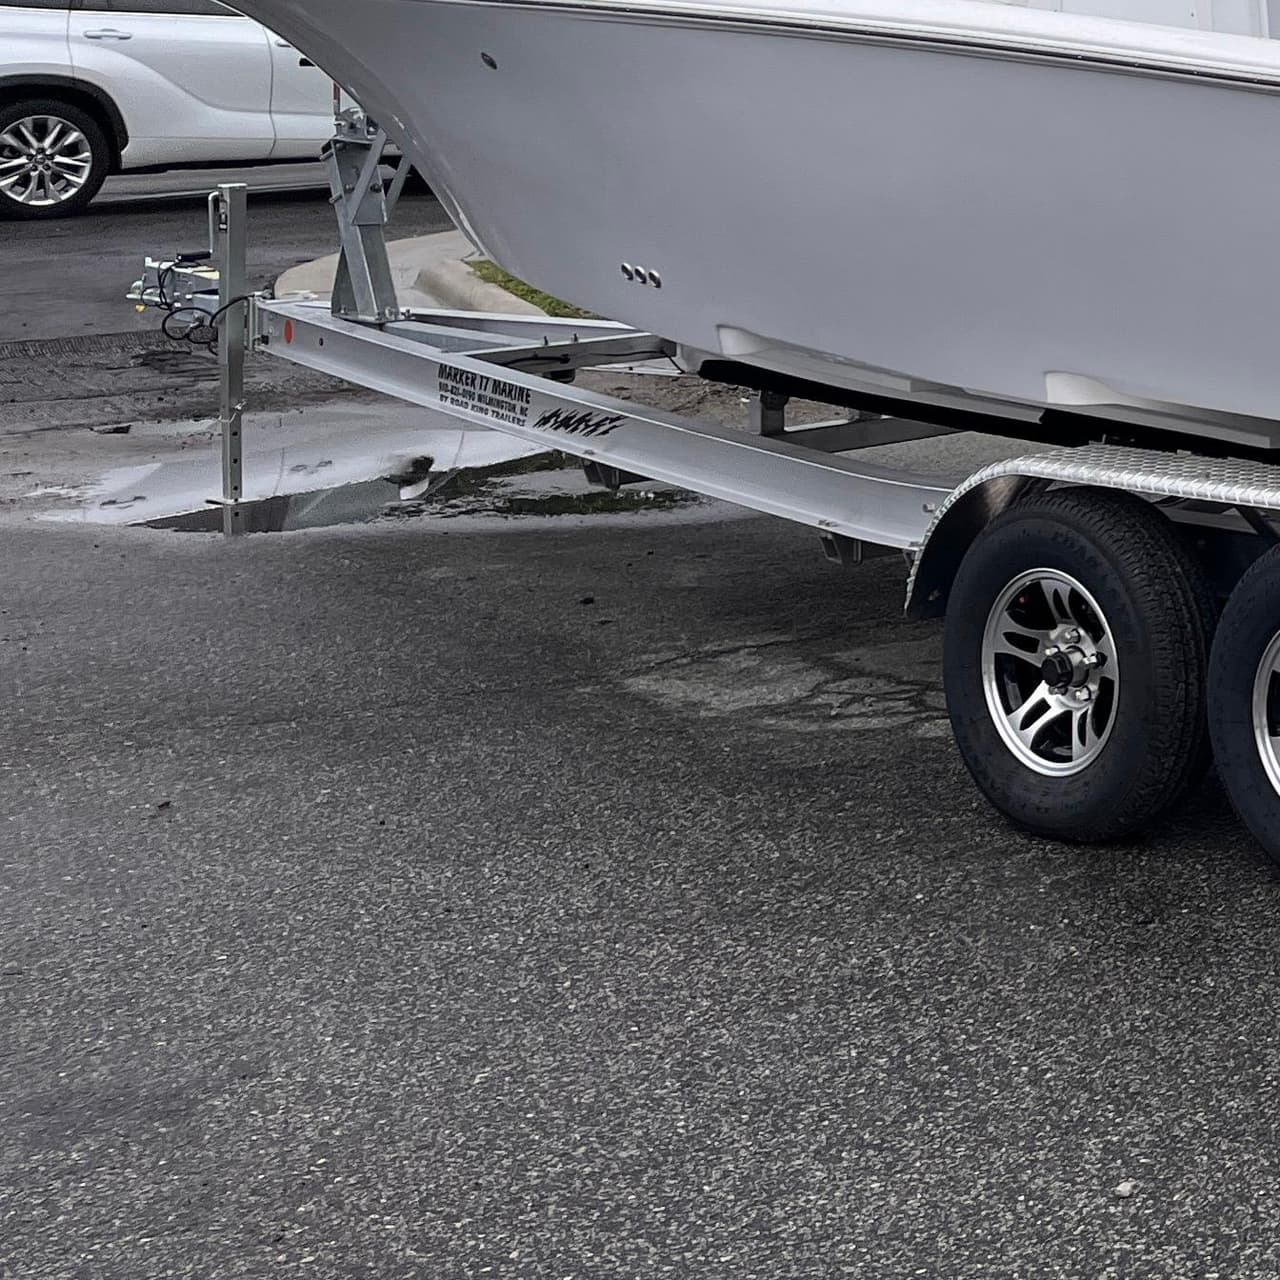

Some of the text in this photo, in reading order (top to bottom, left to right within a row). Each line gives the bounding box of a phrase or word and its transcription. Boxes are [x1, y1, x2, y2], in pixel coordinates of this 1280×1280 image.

[438, 363, 531, 405] MARKER 17 MARINE
[471, 403, 489, 416] KING
